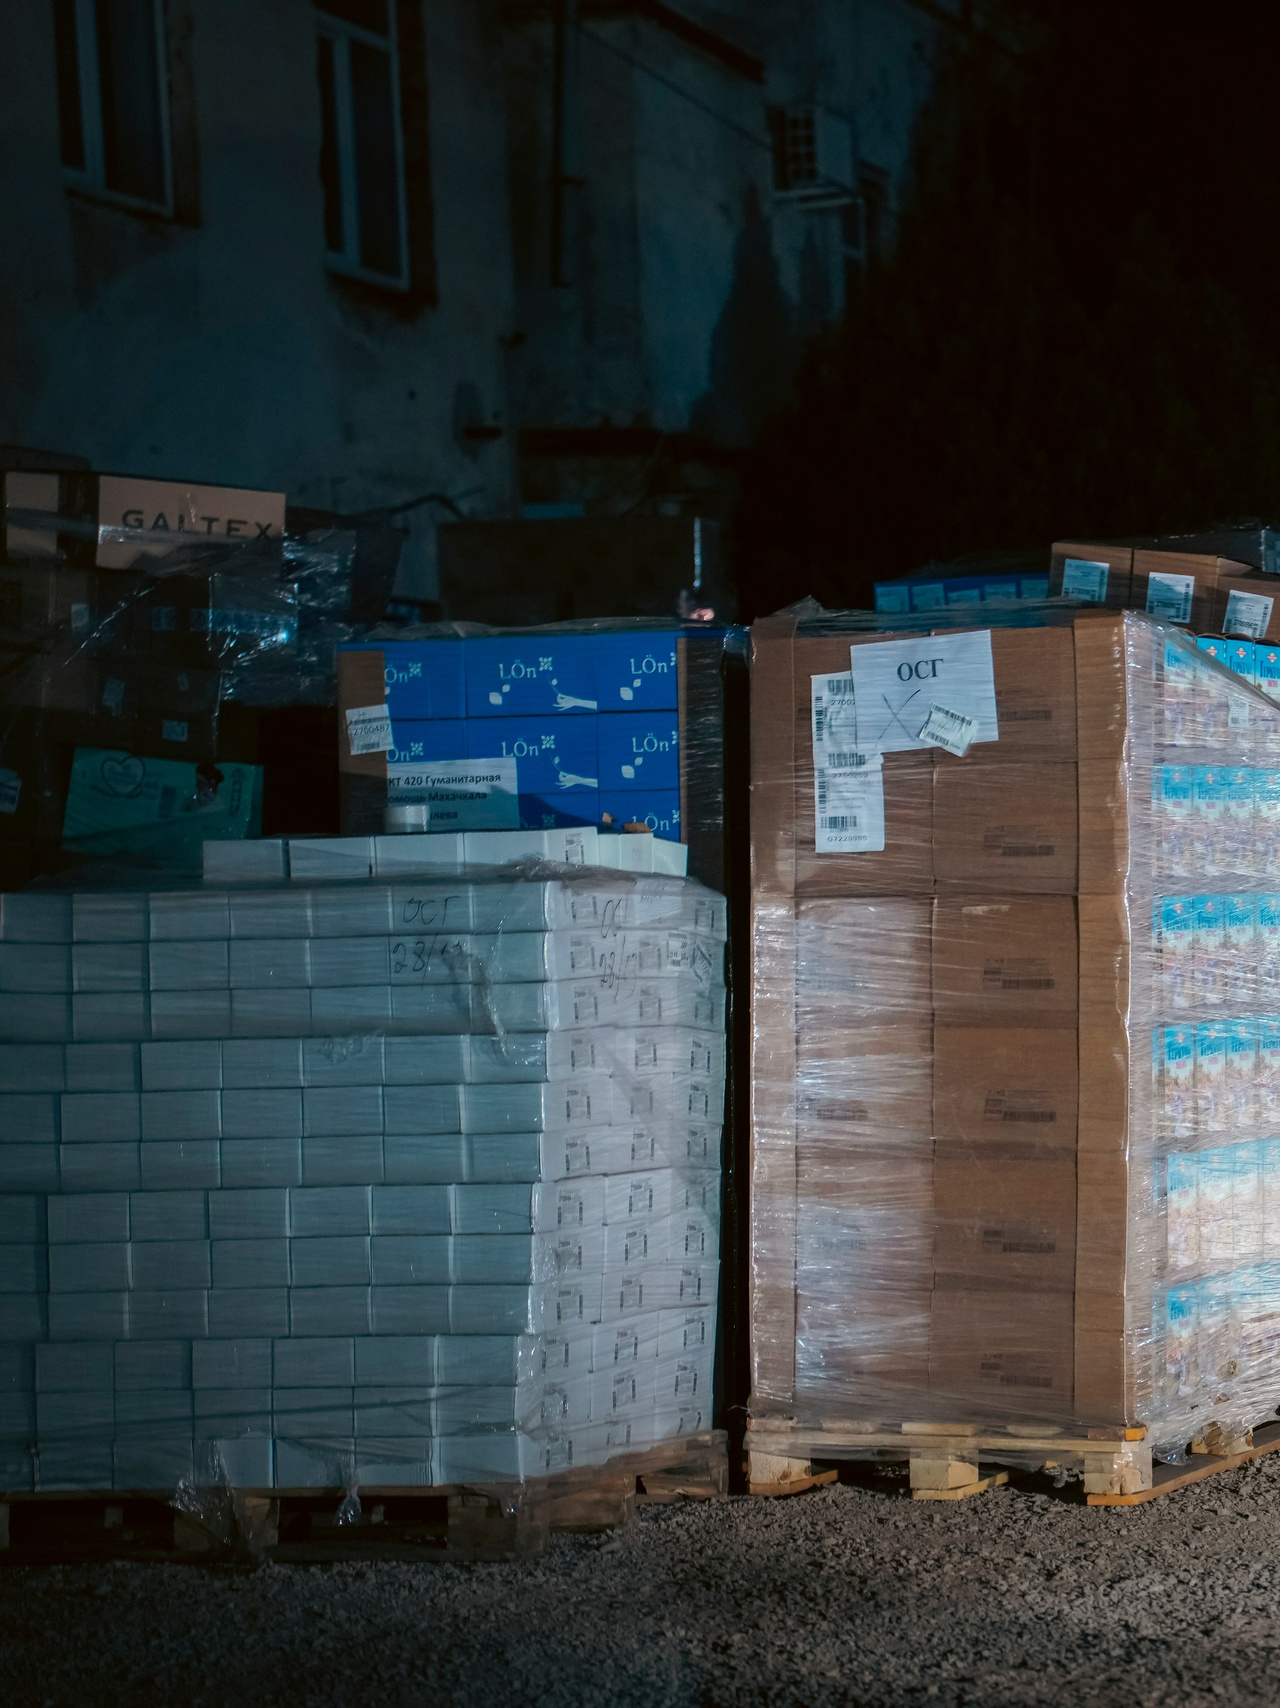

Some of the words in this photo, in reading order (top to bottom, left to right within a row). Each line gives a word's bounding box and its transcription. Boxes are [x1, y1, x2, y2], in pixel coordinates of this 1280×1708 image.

[121, 509, 273, 540] GALTEX
[385, 661, 408, 684] Ön
[498, 659, 537, 680] LÖn
[631, 654, 669, 674] LÖn
[897, 658, 944, 681] ОСГ
[353, 724, 390, 736] 2700487
[501, 737, 539, 758] LÖn
[632, 732, 669, 753] LÖn
[404, 776, 423, 786] 420
[425, 774, 501, 787] Гуманитарная
[388, 794, 425, 804] омощь
[428, 792, 487, 802] Махачкала
